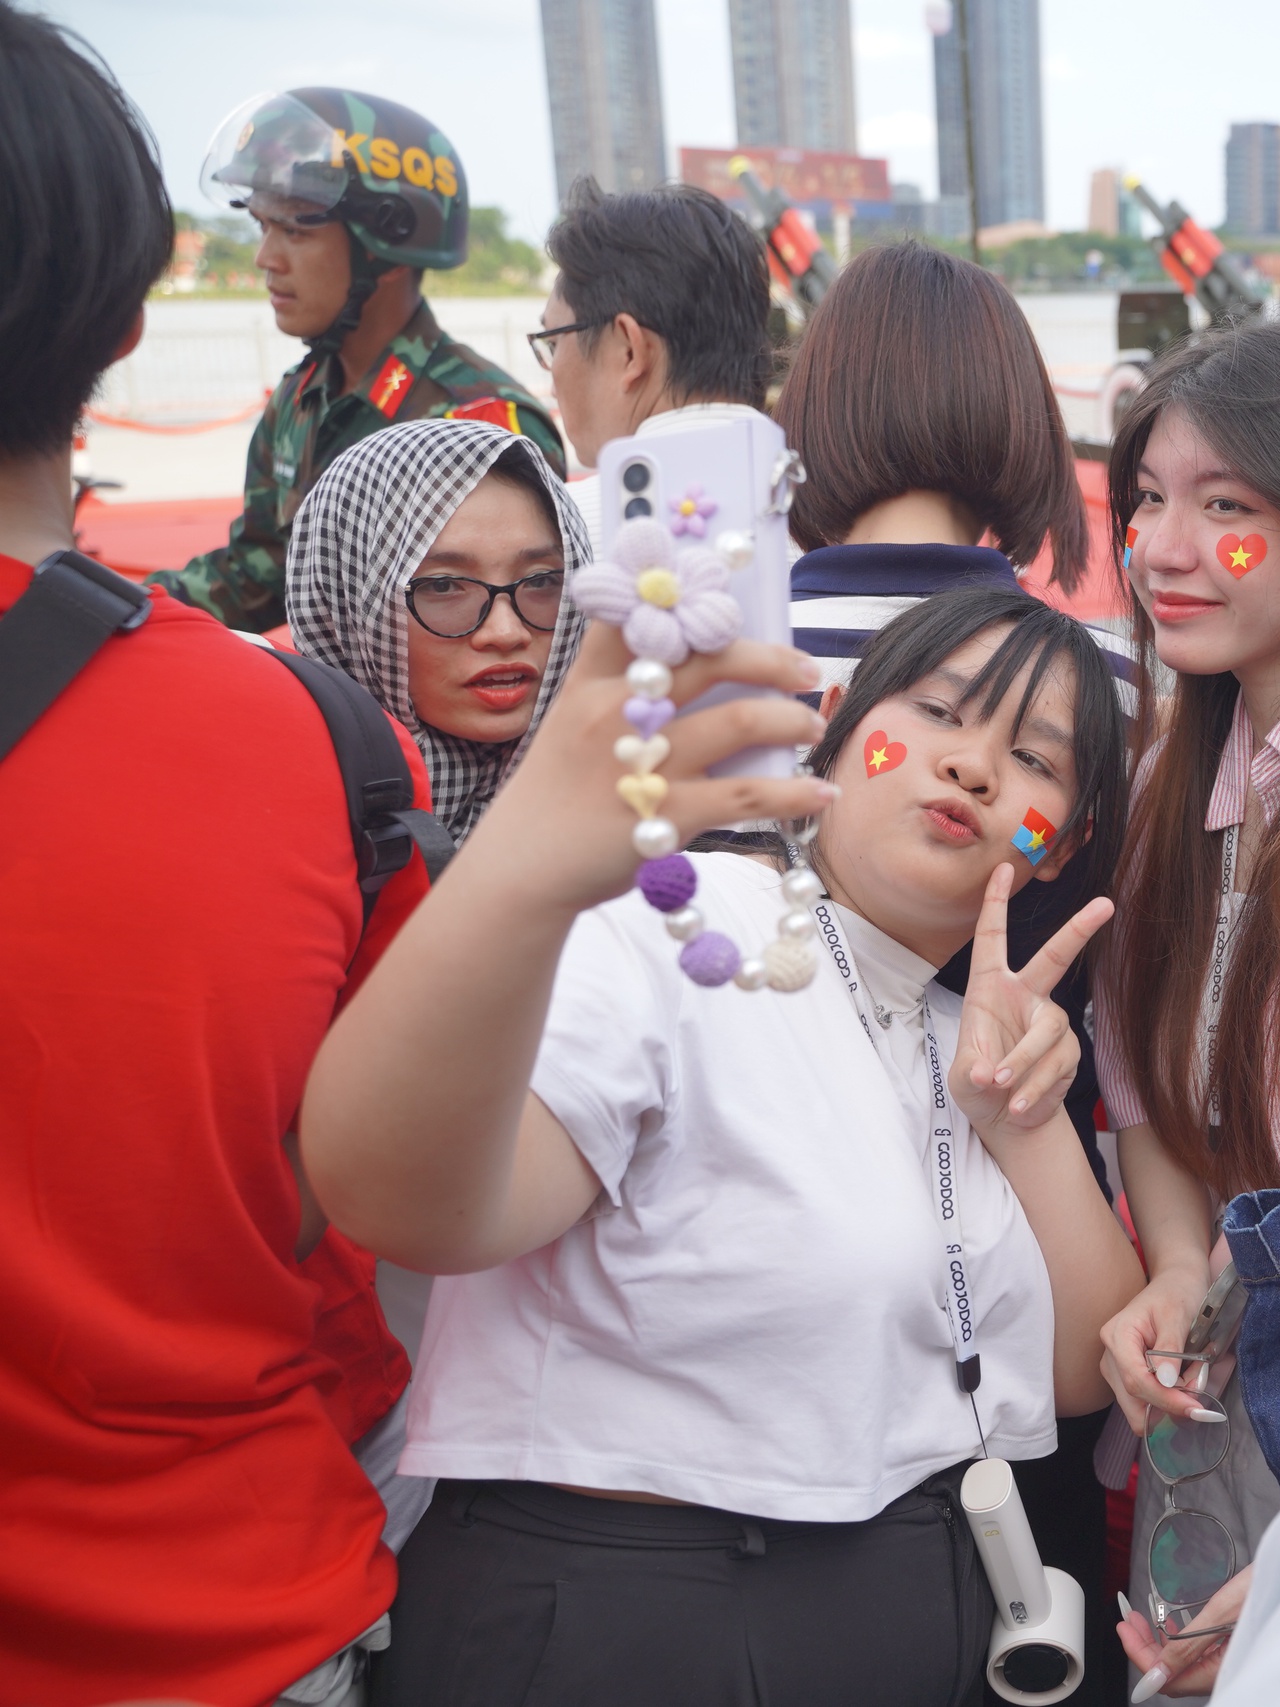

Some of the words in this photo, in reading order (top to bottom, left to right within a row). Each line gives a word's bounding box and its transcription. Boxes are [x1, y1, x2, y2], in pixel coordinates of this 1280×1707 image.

[331, 128, 458, 197] KSQS
[815, 905, 851, 979] GOOJODOQ
[929, 1046, 946, 1109] GOOJODOQ
[937, 1142, 954, 1221] GOOJODOQ
[949, 1260, 972, 1343] GOOJODOQ
